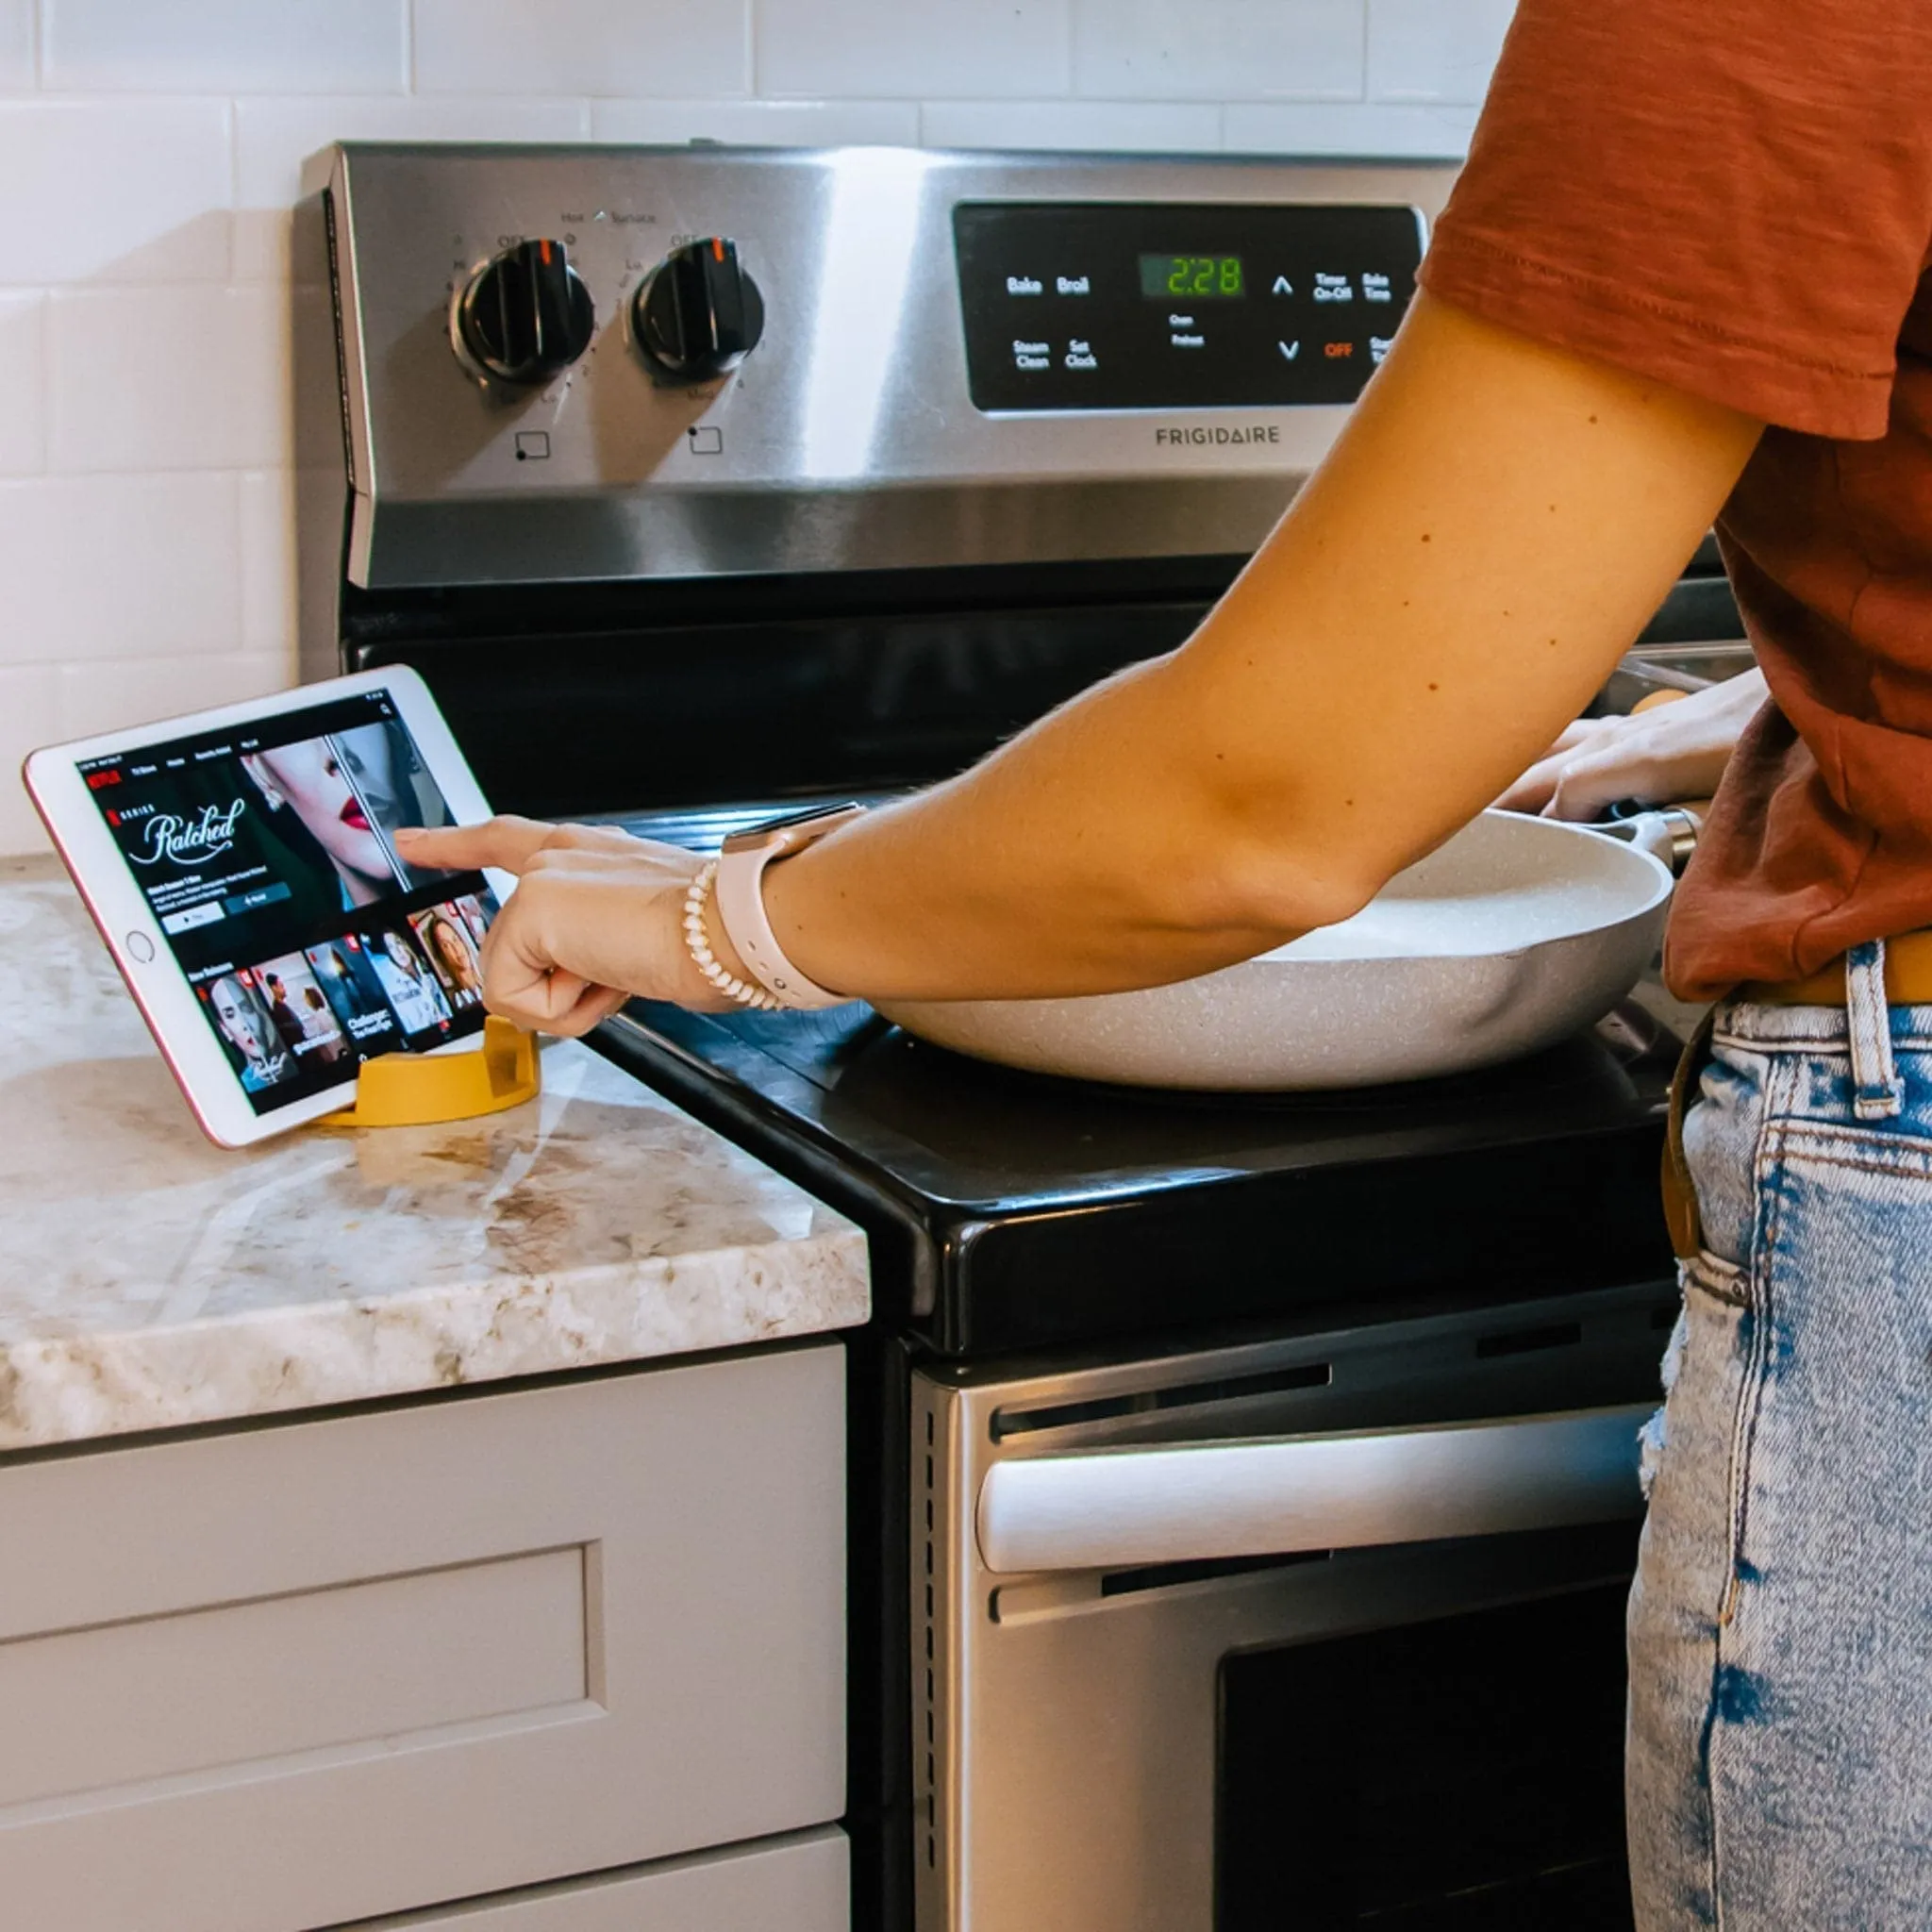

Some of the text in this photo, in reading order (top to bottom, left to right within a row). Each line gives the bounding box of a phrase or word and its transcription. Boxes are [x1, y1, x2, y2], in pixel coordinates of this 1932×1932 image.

[1007, 275, 1043, 294] Bake
[1057, 275, 1090, 294] Broil
[1169, 257, 1241, 294] 2:28
[1324, 342, 1353, 357] OFF
[1065, 354, 1097, 370] Clock
[1156, 425, 1280, 445] FRIGIDAIRE
[128, 798, 245, 865] Ratched
